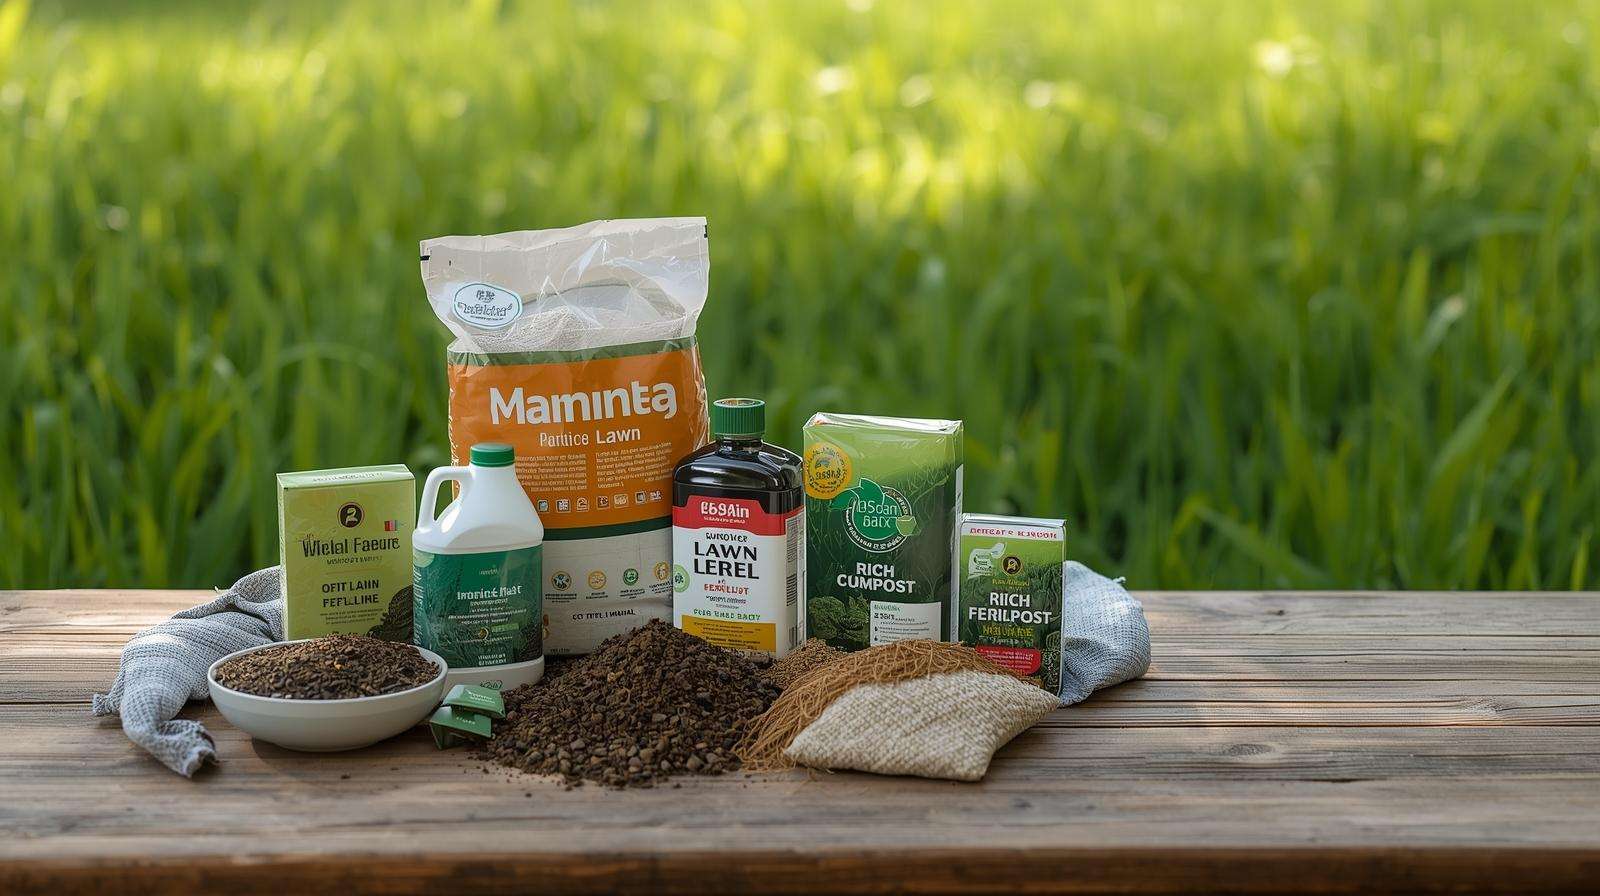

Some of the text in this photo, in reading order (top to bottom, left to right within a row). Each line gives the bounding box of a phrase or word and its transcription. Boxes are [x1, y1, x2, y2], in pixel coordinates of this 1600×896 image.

[596, 428, 641, 444] Lawn
[694, 541, 757, 562] LAWN
[693, 558, 760, 579] LEREL
[856, 562, 895, 578] RICH
[836, 573, 917, 594] CUMPOST
